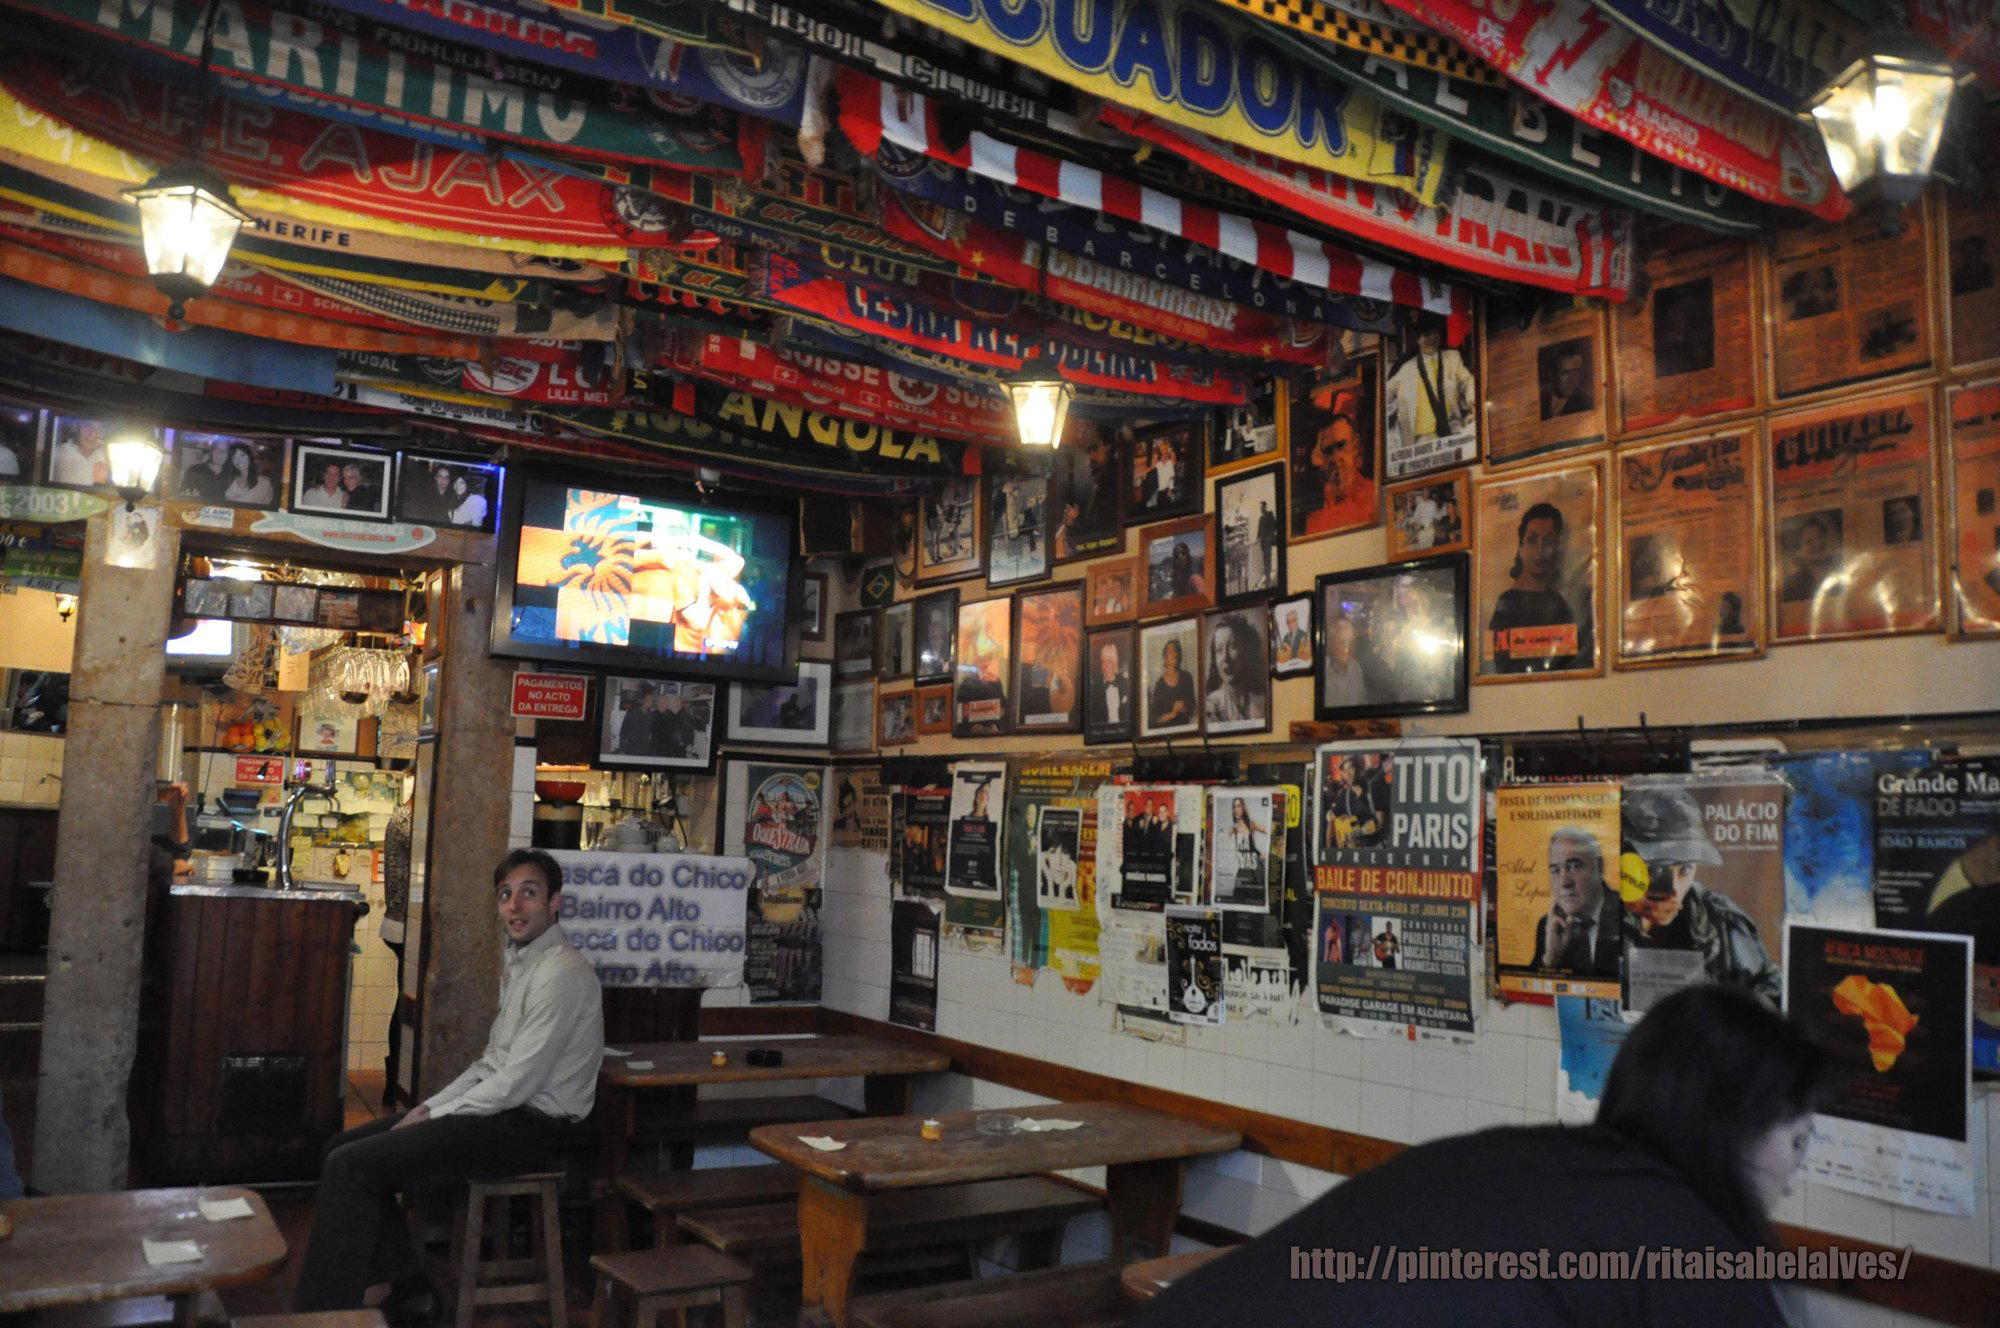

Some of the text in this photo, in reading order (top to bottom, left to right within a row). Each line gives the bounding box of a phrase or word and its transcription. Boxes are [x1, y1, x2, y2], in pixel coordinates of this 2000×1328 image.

[935, 0, 1348, 157] UADOR
[302, 118, 566, 213] AJAX
[547, 386, 579, 401] LILLE
[717, 391, 943, 464] ANGOLA
[518, 678, 582, 691] PAGAMENTOS
[528, 691, 571, 702] NO ACTO
[518, 702, 578, 713] DA ENTREGA
[1393, 754, 1472, 804] TITO
[1877, 771, 1959, 795] Grande
[1704, 799, 1778, 821] PALÁCIO
[1878, 797, 1957, 817] DE FADO
[1392, 812, 1468, 850] PARIS
[1714, 823, 1778, 842] DO FIM
[629, 862, 664, 887] do
[672, 860, 747, 890] Chico
[1317, 867, 1474, 899] BAILE DE CONJUNTO
[560, 893, 701, 921] Bairro Alto
[626, 927, 661, 951] do
[669, 926, 744, 952] Chico
[1187, 930, 1218, 952] fados
[1319, 994, 1361, 1009] PARADISE
[1362, 1000, 1399, 1013] GARAGE
[1401, 1003, 1415, 1015] EM
